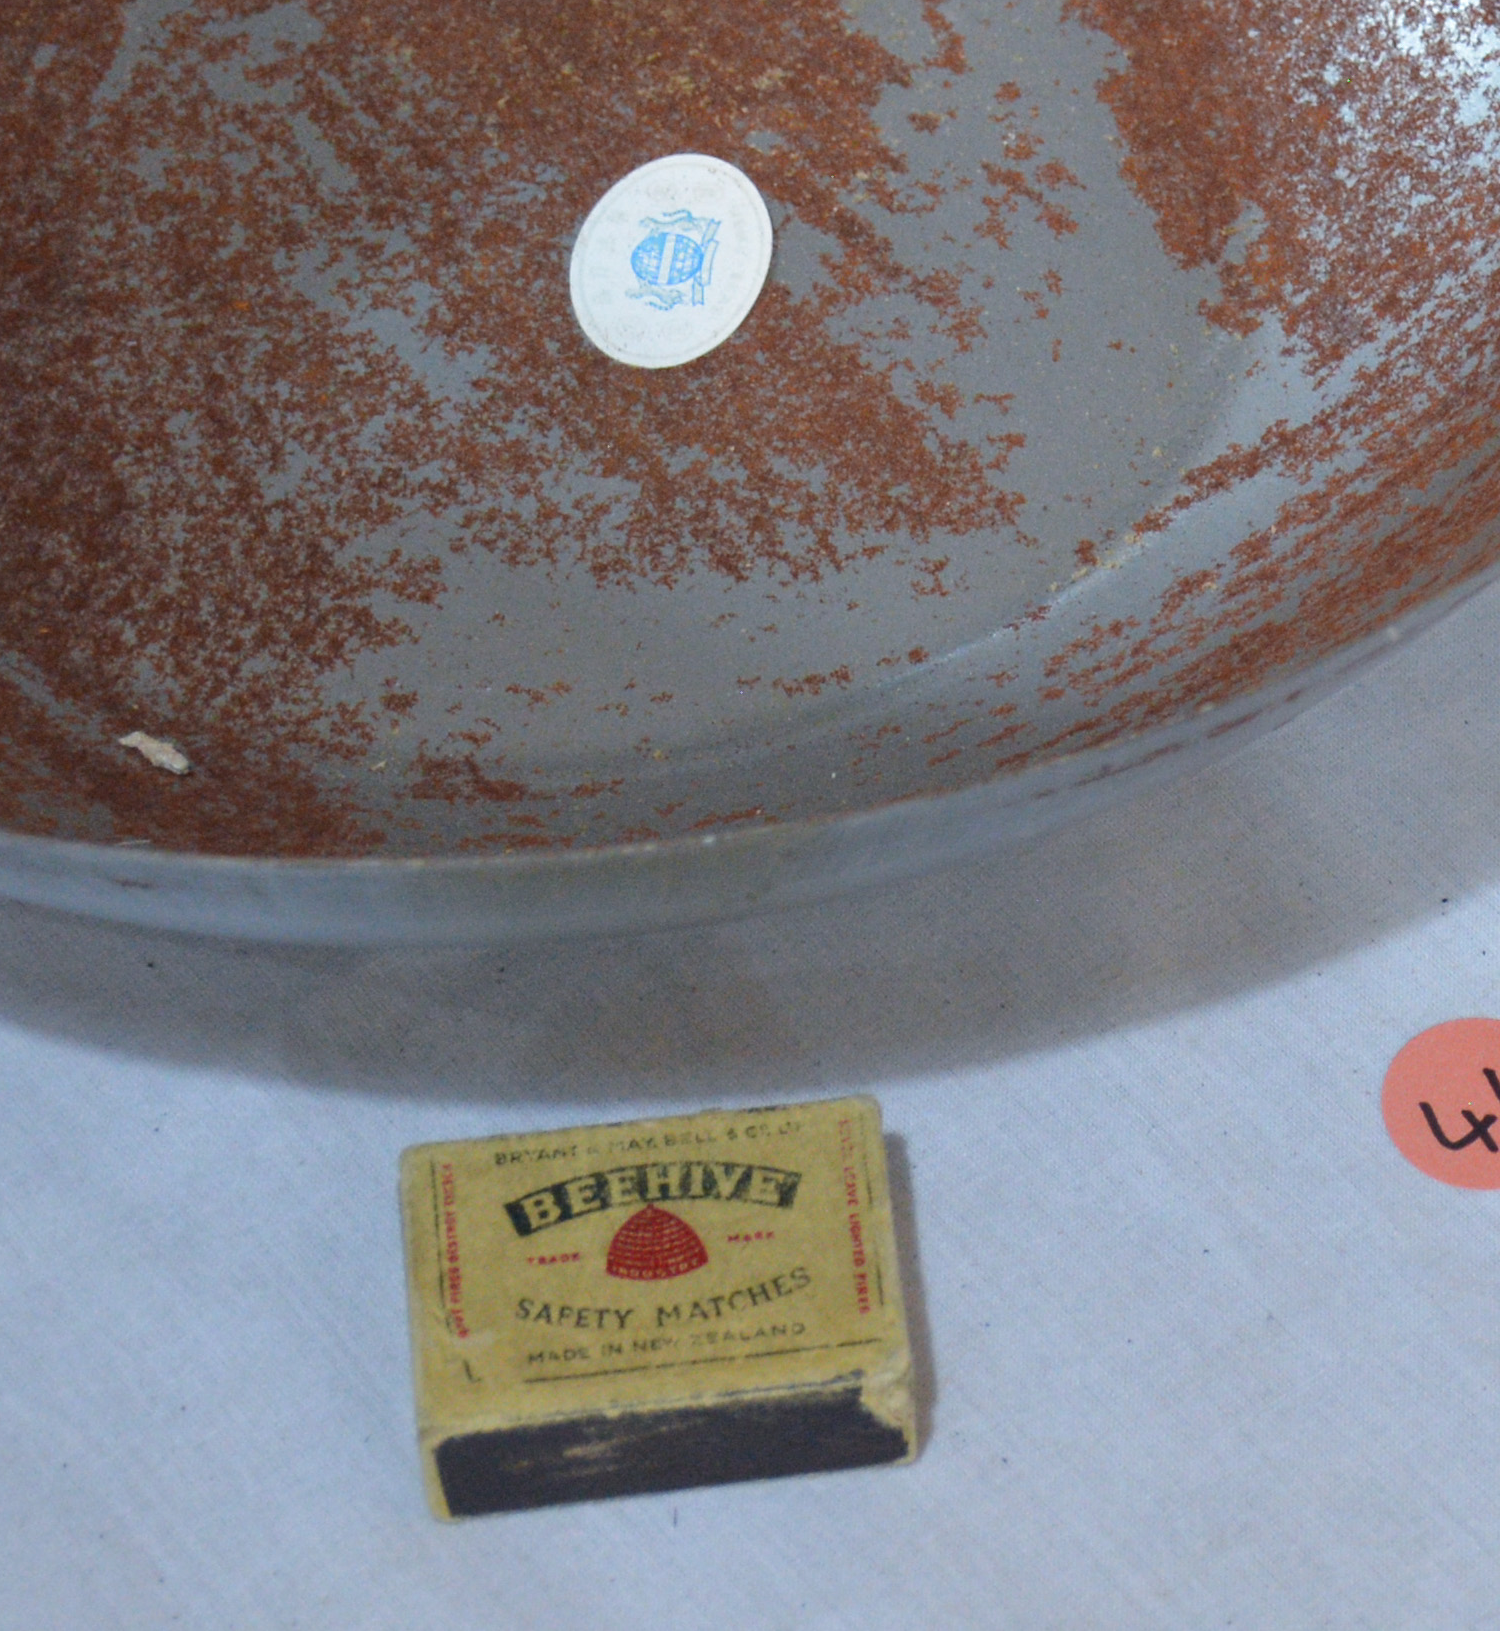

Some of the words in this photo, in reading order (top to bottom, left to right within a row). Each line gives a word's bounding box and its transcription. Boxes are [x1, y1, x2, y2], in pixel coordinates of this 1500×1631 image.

[519, 1162, 788, 1230] BEEHIVE
[525, 1251, 581, 1267] TRADE
[726, 1229, 776, 1244] MARK
[514, 1297, 635, 1330] SAFETY
[655, 1266, 813, 1328] MATCHES
[527, 1347, 591, 1366] MADE
[601, 1342, 623, 1358] IN
[690, 1321, 807, 1347] ZEALAND
